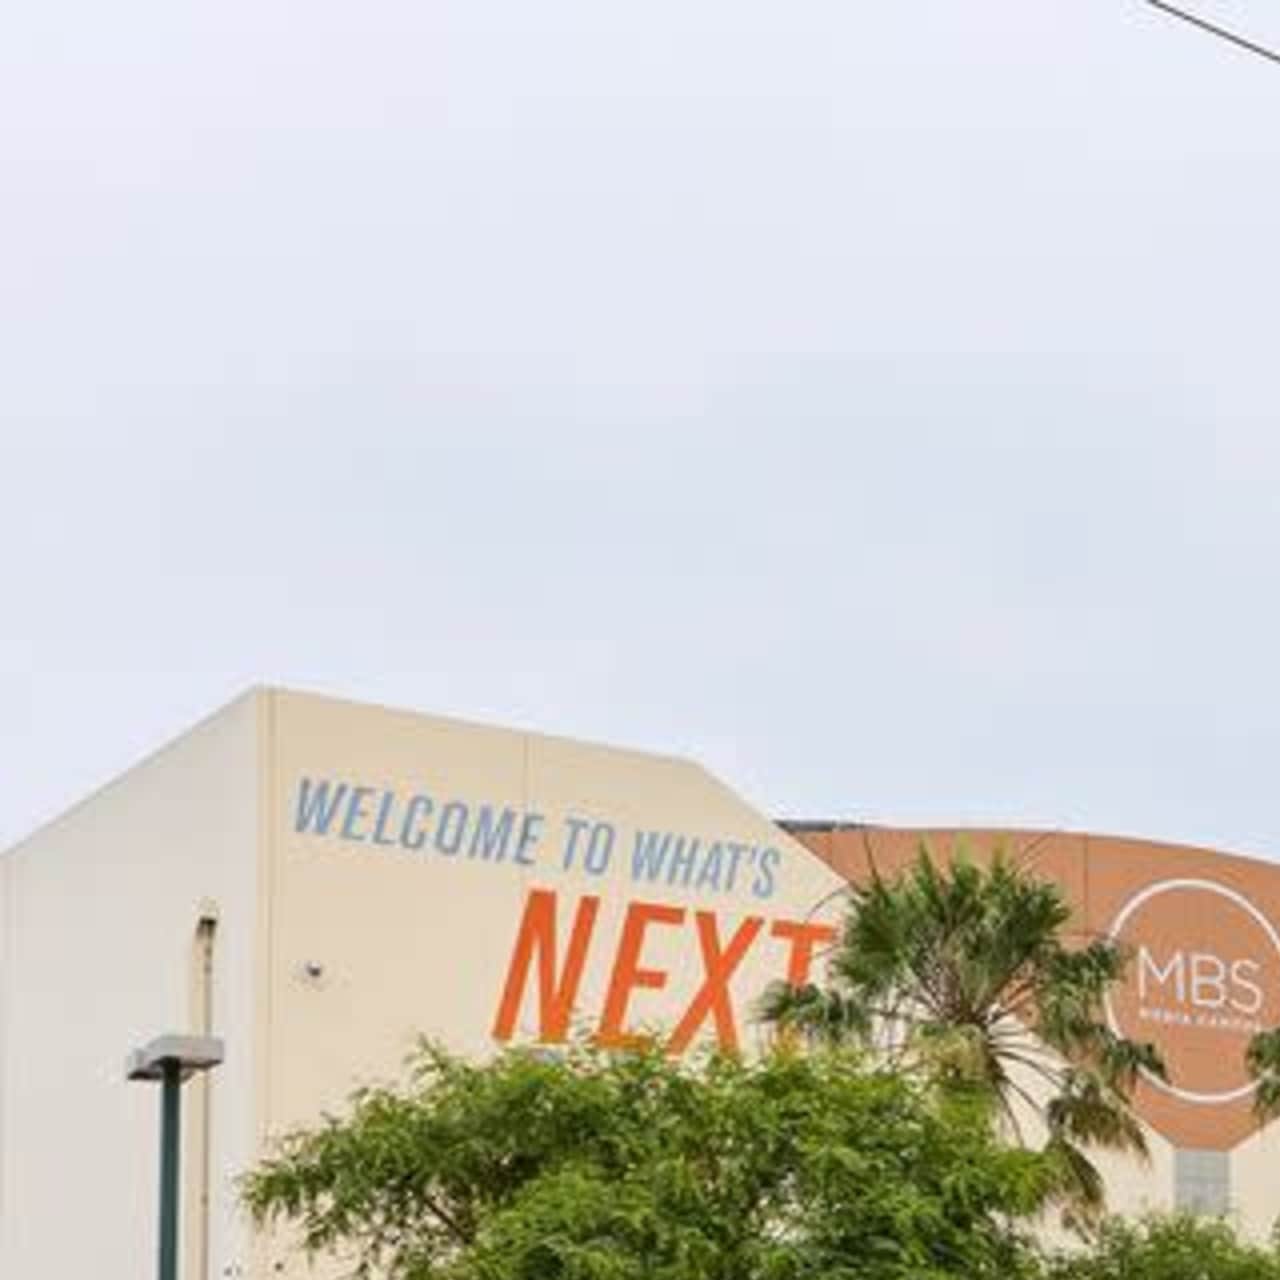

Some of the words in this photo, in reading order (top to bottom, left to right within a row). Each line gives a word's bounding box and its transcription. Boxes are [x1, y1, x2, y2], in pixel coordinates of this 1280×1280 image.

[295, 777, 545, 866] WELCOME
[562, 816, 618, 877] TO
[629, 830, 781, 899] WHAT'S
[1138, 945, 1263, 1014] MBS
